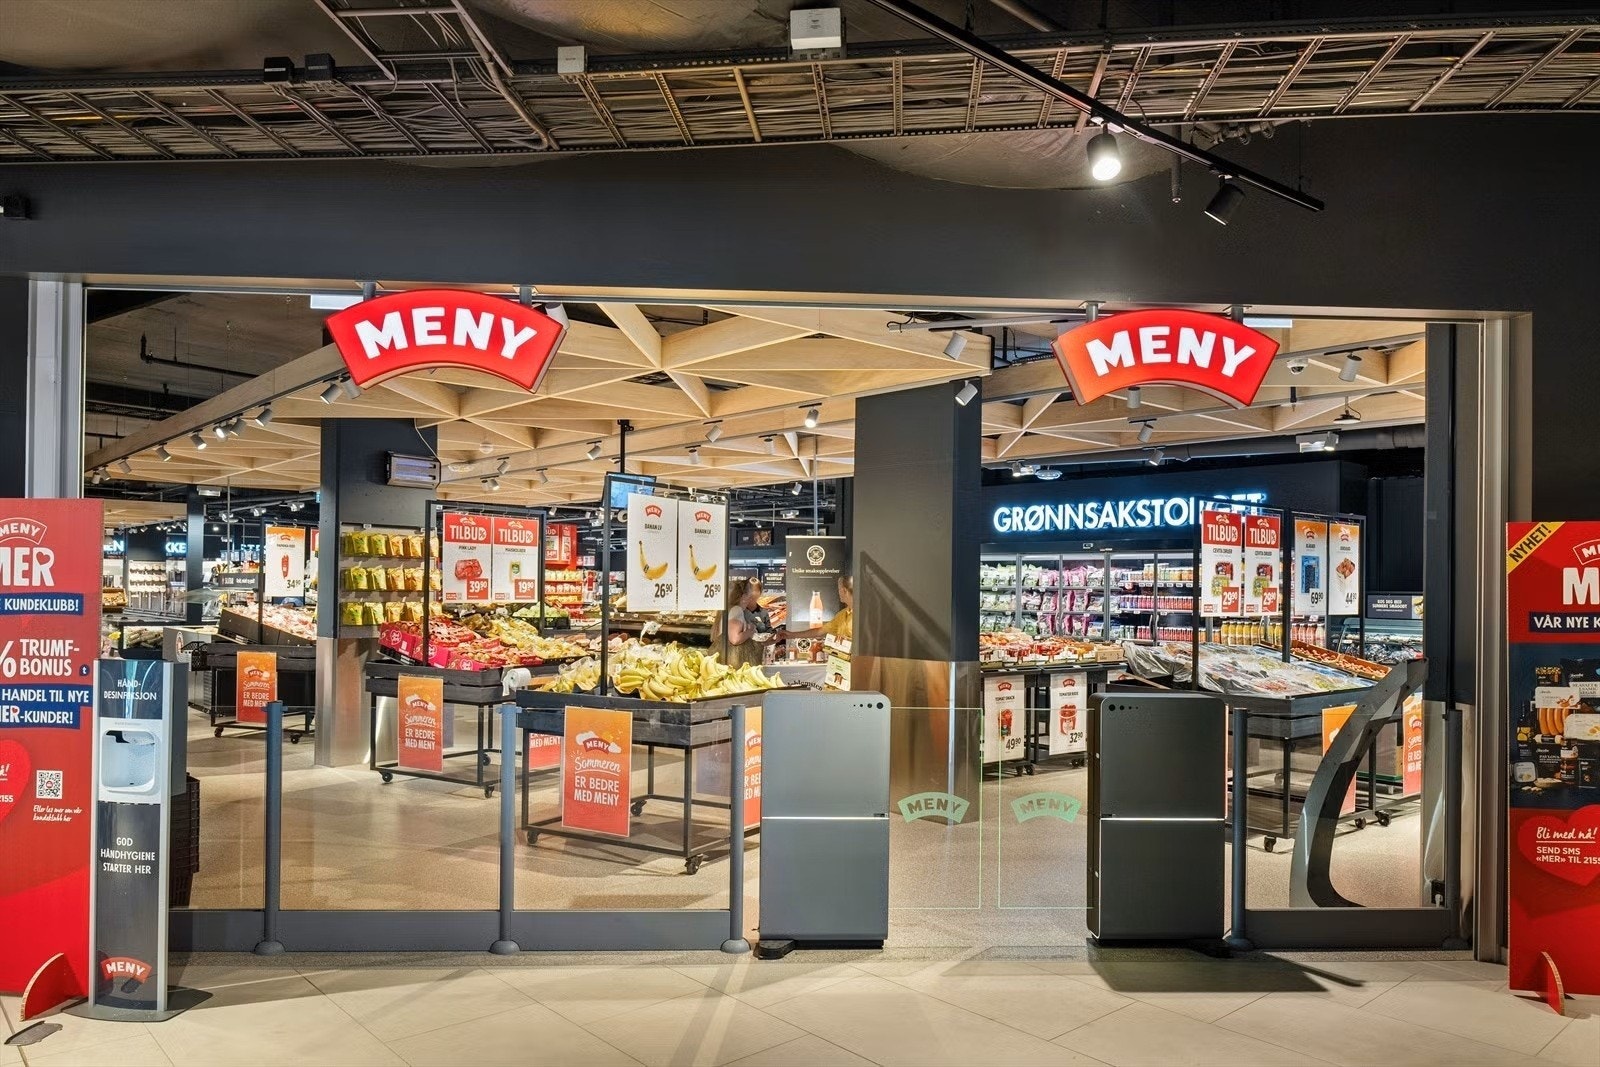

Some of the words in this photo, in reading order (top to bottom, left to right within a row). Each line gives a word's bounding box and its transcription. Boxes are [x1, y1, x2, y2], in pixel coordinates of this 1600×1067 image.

[354, 307, 537, 360] MENY
[1085, 326, 1256, 377] MENY
[449, 525, 488, 541] TILBUD
[498, 528, 534, 544] TILBUD
[1207, 523, 1239, 542] TILBUD
[1249, 527, 1277, 545] TILBUD
[1509, 523, 1552, 562] NYHET!
[4, 598, 79, 611] KUNDEKLUBB!
[1533, 614, 1562, 629] VÅR
[1566, 616, 1589, 629] NYE
[20, 638, 80, 657] TRUMF-
[20, 658, 73, 677] BONUS
[117, 679, 142, 688] HÅND-
[2, 688, 47, 702] HANDEL
[49, 690, 65, 703] TIL
[68, 690, 89, 703] NYE
[103, 690, 157, 700] DESINFEKSJON
[414, 728, 436, 741] BEDRE
[418, 739, 436, 751] MENY
[586, 740, 609, 750] MENY
[575, 756, 621, 773] Sommeren
[575, 775, 587, 788] ER
[589, 777, 620, 793] BEDRE
[574, 789, 592, 802] MED
[593, 794, 620, 806] MENY
[906, 798, 961, 814] MENY
[1018, 798, 1074, 814] MENY
[1536, 827, 1551, 840] Bli
[1552, 827, 1577, 839] med
[1577, 826, 1599, 840] nå!
[116, 837, 134, 847] GOD
[100, 848, 156, 861] HÅNDHYGIENE
[1536, 846, 1561, 855] SEND
[1562, 847, 1581, 855] SMS
[1567, 855, 1582, 864] TIL
[102, 862, 132, 874] STARTER
[134, 865, 152, 875] HER
[106, 961, 146, 976] MENY
